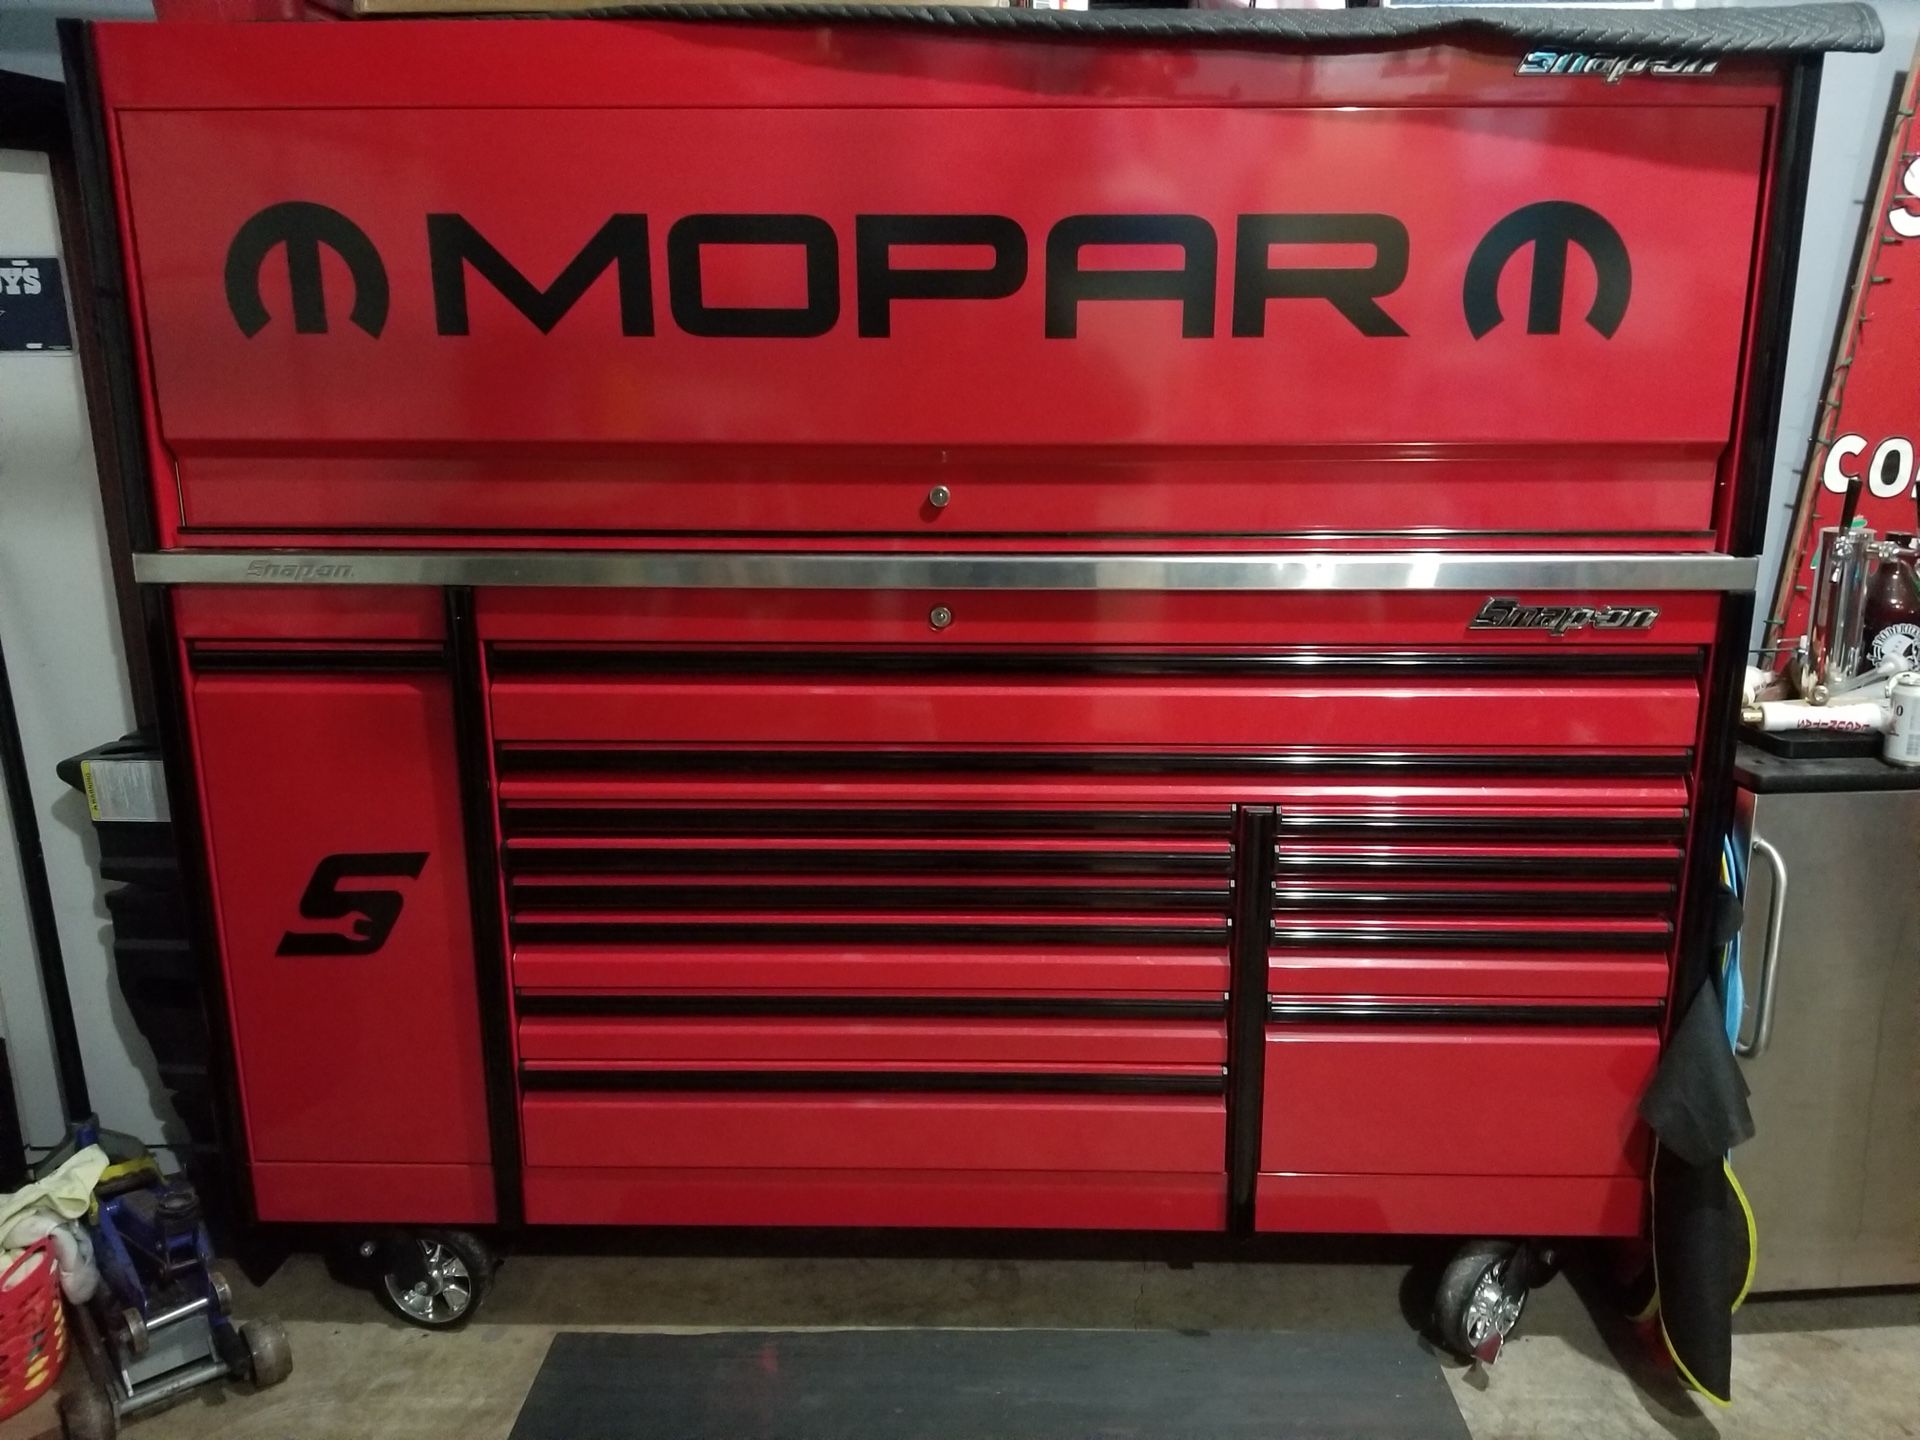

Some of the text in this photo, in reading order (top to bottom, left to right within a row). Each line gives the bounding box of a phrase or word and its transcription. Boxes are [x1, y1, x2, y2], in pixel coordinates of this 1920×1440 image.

[427, 213, 1410, 338] MOPAR
[1822, 432, 1920, 499] CO
[1468, 596, 1661, 636] Snap-on
